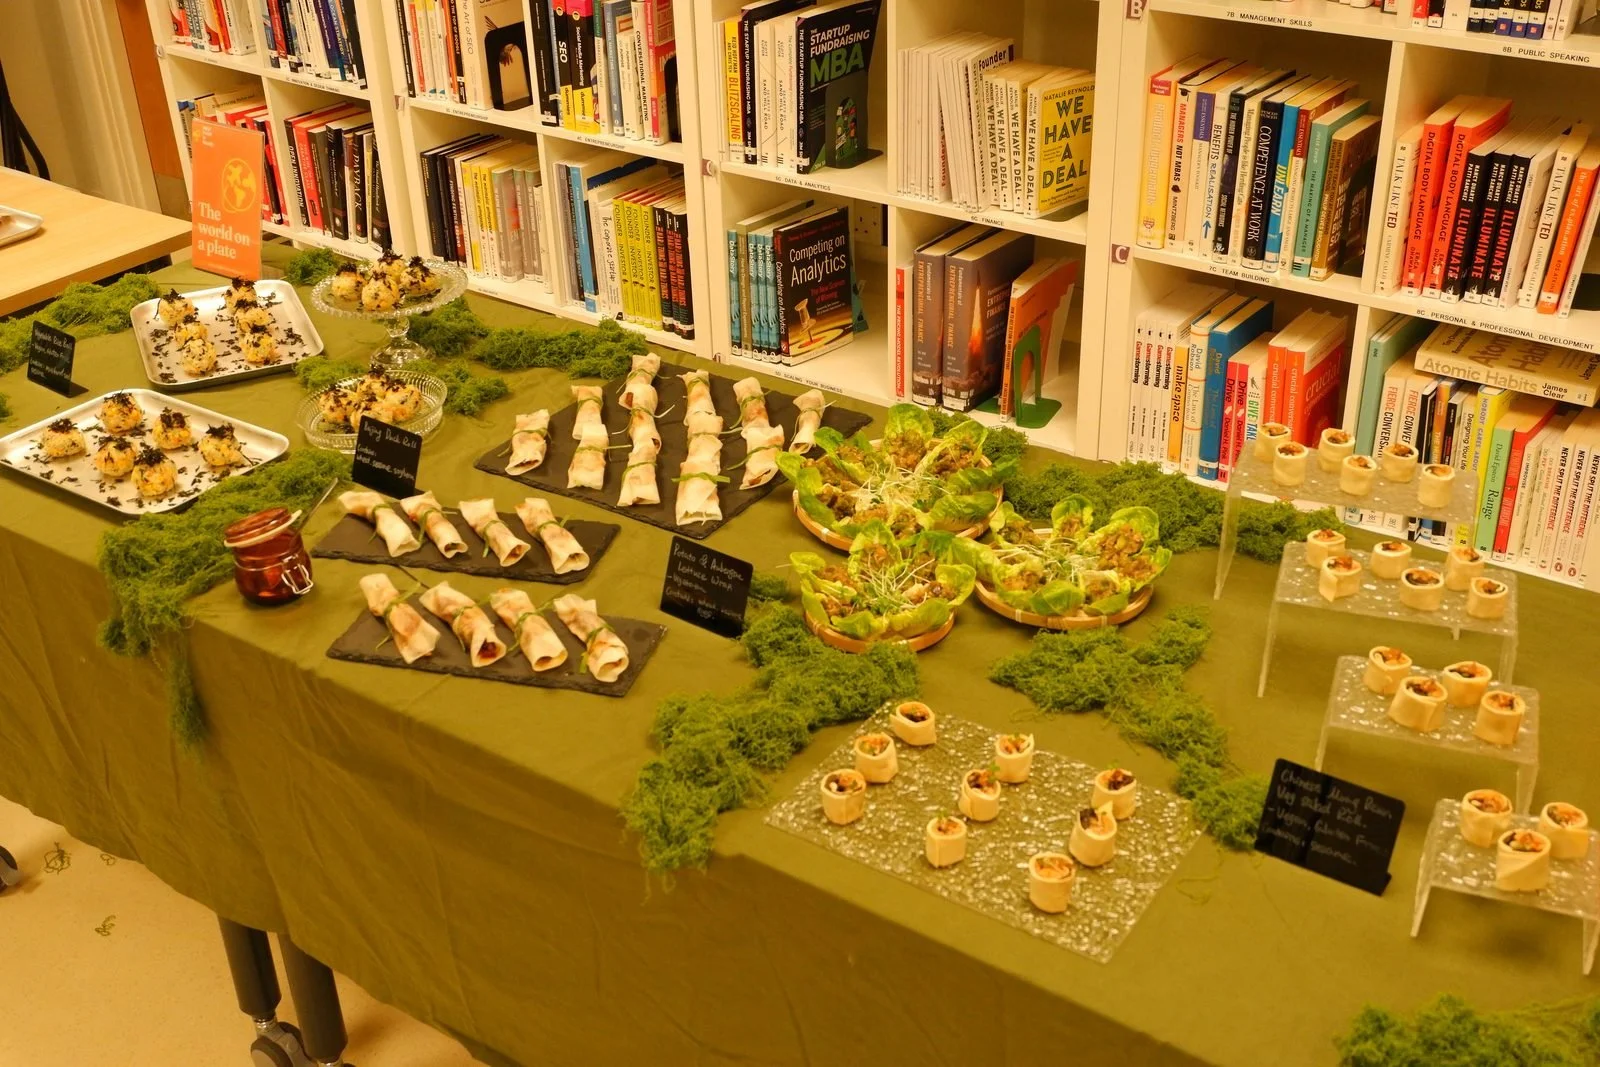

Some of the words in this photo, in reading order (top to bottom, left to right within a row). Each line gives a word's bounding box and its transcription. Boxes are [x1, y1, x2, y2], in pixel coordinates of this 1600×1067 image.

[1240, 13, 1286, 25] MANAGEMENT
[1289, 19, 1313, 27] SKILLS
[810, 24, 851, 46] STARTUP
[810, 29, 871, 58] FUNDRAISING
[559, 40, 568, 64] SEO
[1518, 48, 1545, 58] PUBLIC
[1549, 52, 1590, 63] SPEAKING
[635, 31, 646, 86] CONVERSATIONAL
[641, 86, 649, 122] MARKETING
[810, 42, 865, 89] MBA
[1044, 90, 1066, 101] NATALIE
[1068, 85, 1095, 96] REYNOLD
[728, 77, 741, 141] BLITZSCALING
[987, 105, 995, 121] WE
[997, 109, 1004, 125] WE
[1011, 112, 1019, 128] WE
[1056, 96, 1084, 119] WE
[988, 122, 997, 149] HAVE
[1028, 118, 1036, 134] WE
[1044, 115, 1092, 145] HAVE
[1177, 103, 1187, 143] MANAGERS
[998, 127, 1006, 154] HAVE
[1012, 130, 1020, 157] HAVE
[1028, 137, 1036, 163] HAVE
[1061, 142, 1072, 161] A
[1175, 144, 1183, 159] NOT
[1210, 124, 1222, 160] BENEFITS
[989, 151, 996, 160] A
[1000, 156, 1006, 165] A
[1014, 159, 1021, 168] A
[1253, 125, 1272, 195] COMPETENCE
[289, 145, 297, 165] OPEN
[293, 165, 304, 208] INNOVATION
[991, 163, 999, 186] DEAL
[1000, 167, 1008, 191] DEAL
[1014, 170, 1022, 194] DEAL
[1027, 166, 1034, 175] A
[1042, 160, 1087, 188] DEAL
[1173, 160, 1182, 182] MBAS
[1393, 157, 1405, 184] TALK
[1422, 168, 1431, 193] BODY
[1450, 169, 1460, 195] BODY
[1551, 167, 1566, 192] TALK
[1026, 175, 1034, 200] DEAL
[1205, 162, 1217, 219] REALISATION
[1271, 164, 1287, 216] UNLEARN
[1391, 185, 1401, 209] LIKE
[1468, 181, 1477, 202] DUARTE
[1494, 181, 1502, 202] DUARTE
[1512, 183, 1521, 204] DUARTE
[199, 201, 221, 221] The
[1170, 196, 1178, 231] MINTZBERG
[1252, 195, 1262, 211] AT
[1545, 195, 1558, 221] LIKE
[643, 210, 651, 244] FOUNDER
[982, 217, 1004, 226] FINANCE
[1247, 212, 1262, 242] WORK
[1387, 211, 1398, 229] TED
[1413, 193, 1427, 241] LANGUAGE
[1438, 195, 1452, 242] LANGUAGE
[198, 222, 233, 242] world
[234, 232, 250, 246] on
[615, 204, 623, 237] FOUNDER
[619, 243, 627, 276] INVESTOR
[626, 206, 634, 239] FOUNDER
[630, 245, 638, 279] INVESTOR
[1472, 208, 1496, 279] ILLUMINATE
[1539, 222, 1552, 240] TED
[198, 239, 205, 251] a
[206, 240, 237, 260] plate
[790, 239, 833, 263] Competing
[835, 235, 845, 247] on
[1448, 208, 1471, 280] ILLUMINATE
[1490, 210, 1515, 281] ILLUMINATE
[646, 251, 654, 284] INVESTOR
[791, 254, 846, 287] Analytics
[1222, 268, 1239, 276] TEAM
[1241, 272, 1270, 283] BUILDING
[778, 295, 784, 305] on
[1431, 311, 1467, 325] PERSONAL
[1480, 322, 1534, 338] PROFESSIONAL
[1538, 334, 1594, 350] DEVELOPMENT
[1133, 341, 1142, 384] Gamestorming
[1143, 343, 1153, 386] Gamestorming
[1153, 345, 1164, 388] Gamestorming
[1163, 346, 1173, 390] Gamestorming
[1189, 344, 1197, 371] Robson
[1195, 348, 1203, 370] David
[1175, 365, 1185, 393] make
[1290, 368, 1298, 394] crucial
[1423, 358, 1481, 381] Atomic
[1485, 373, 1538, 393] Habits
[1542, 383, 1568, 393] James
[1226, 379, 1235, 403] Drive
[1237, 380, 1247, 406] Drive
[1404, 390, 1419, 416] FIERCE
[1543, 389, 1565, 400] Clear
[1171, 394, 1181, 422] space
[1248, 400, 1259, 419] GIVE
[1463, 413, 1474, 445] Designing
[1460, 459, 1468, 470] Life
[1462, 445, 1470, 459] Your
[1493, 443, 1503, 464] David
[1560, 446, 1569, 467] NEVER
[1577, 450, 1585, 470] NEVER
[1489, 464, 1500, 483] Epstein
[1557, 467, 1565, 484] SPLIT
[1574, 470, 1582, 487] SPLIT
[1589, 474, 1597, 492] SPLIT
[1555, 485, 1563, 495] THE
[1571, 487, 1579, 499] THE
[1482, 489, 1500, 520] Range
[1546, 495, 1560, 531] DIFFERENCE
[1562, 499, 1576, 534] DIFFERENCE
[1576, 504, 1591, 538] DIFFERENCE
[673, 543, 696, 562] Potato
[710, 558, 744, 581] Aubergine
[678, 561, 707, 581] Lettuce
[1276, 785, 1297, 806] Veg
